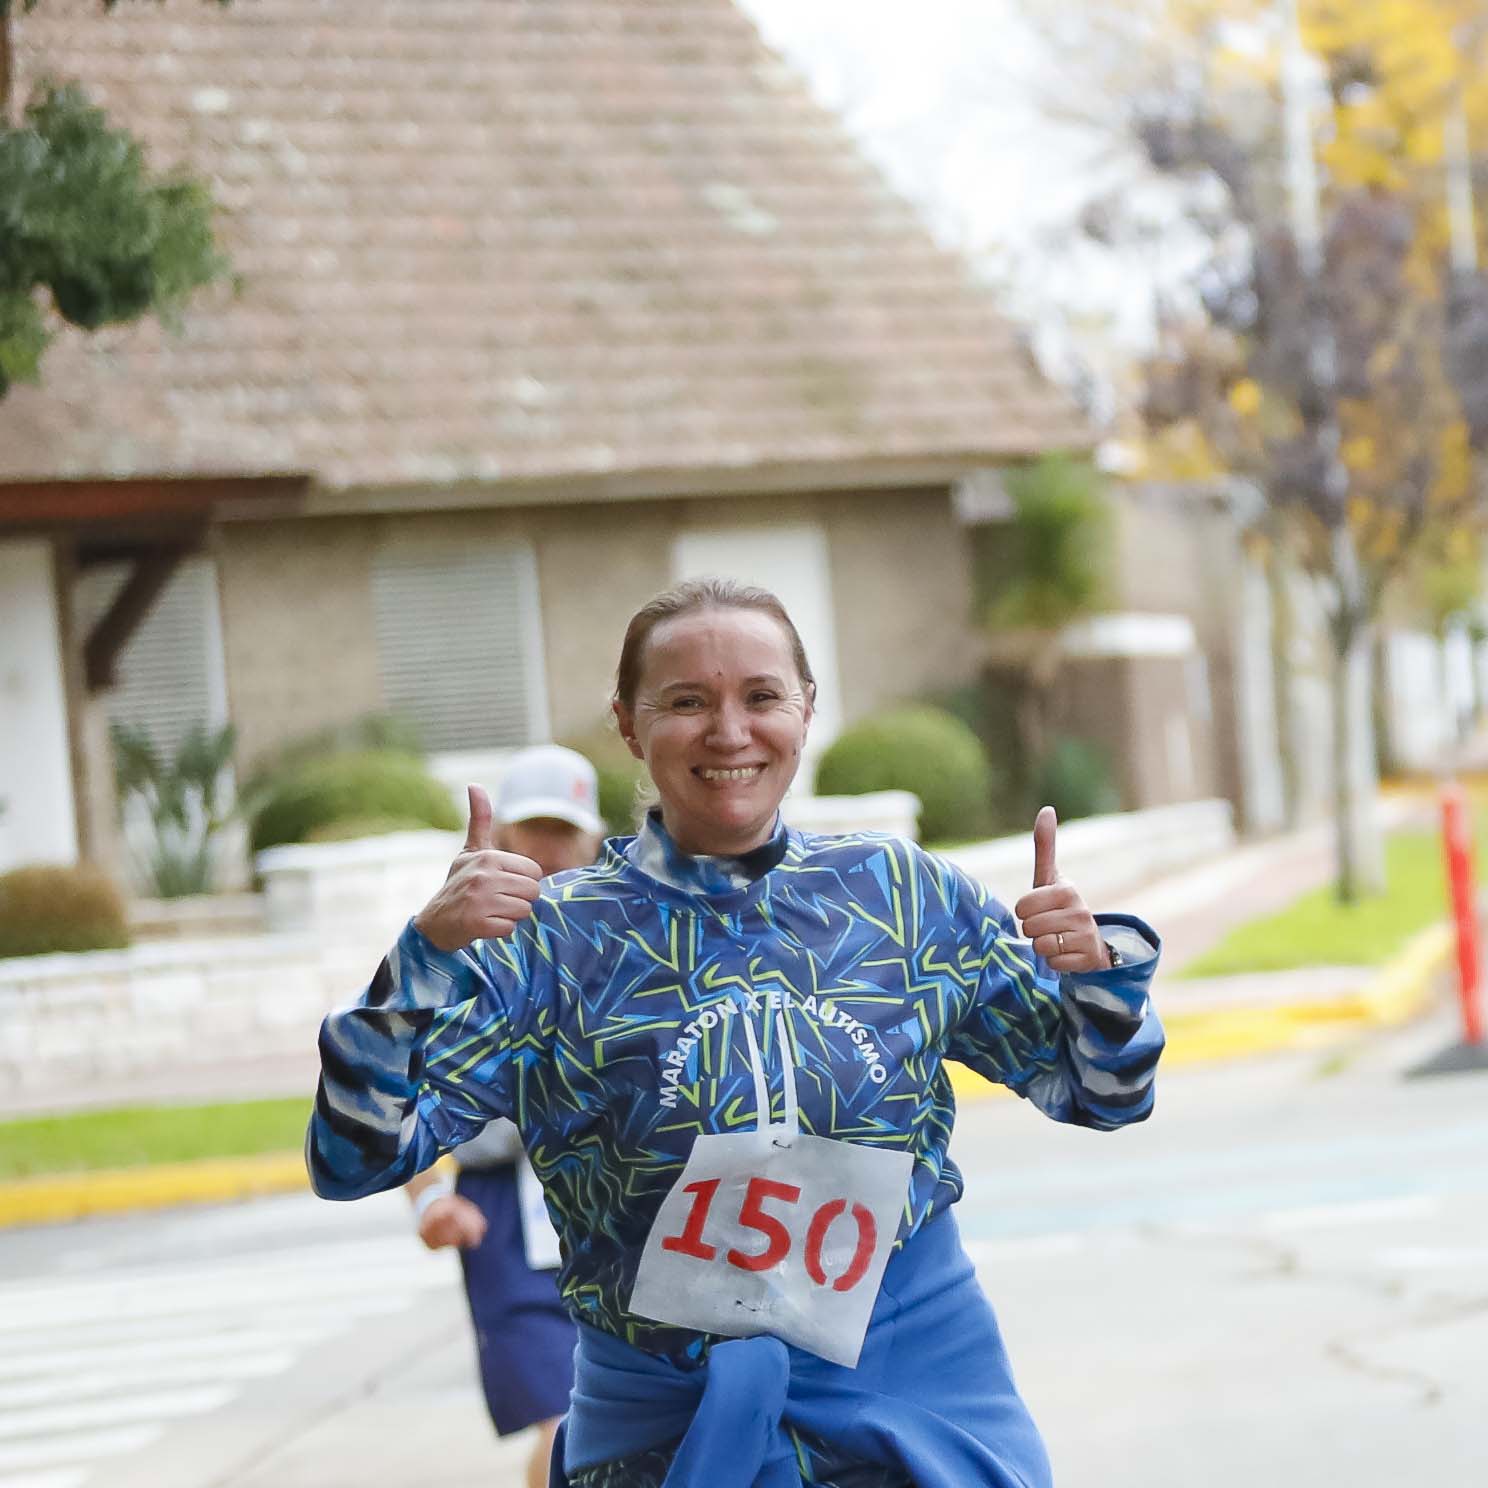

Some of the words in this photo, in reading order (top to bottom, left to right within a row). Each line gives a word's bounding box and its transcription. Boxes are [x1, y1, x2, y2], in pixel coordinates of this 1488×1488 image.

[743, 991, 763, 1011] X
[770, 990, 796, 1010] EL
[802, 994, 888, 1084] AUTISMO
[661, 1176, 879, 1293] 150
